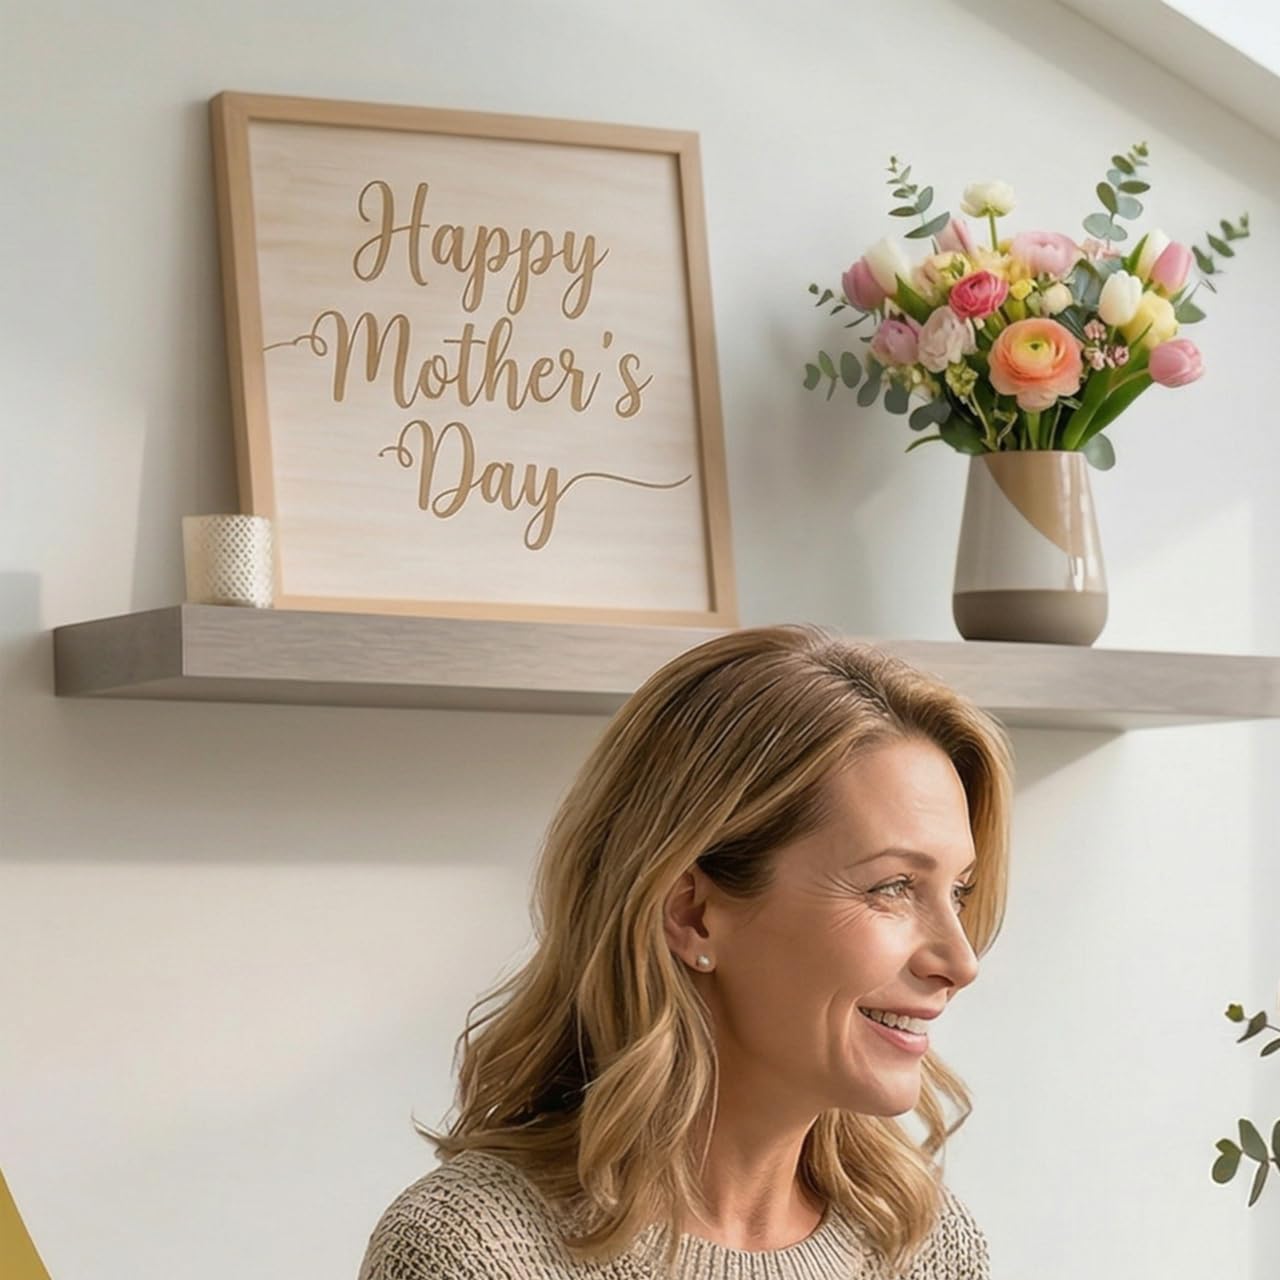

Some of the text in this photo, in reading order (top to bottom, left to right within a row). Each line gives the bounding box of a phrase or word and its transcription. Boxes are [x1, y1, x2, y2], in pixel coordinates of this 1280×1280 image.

[353, 180, 609, 319] Happy
[263, 310, 653, 418] Mother's
[379, 420, 692, 551] Day
